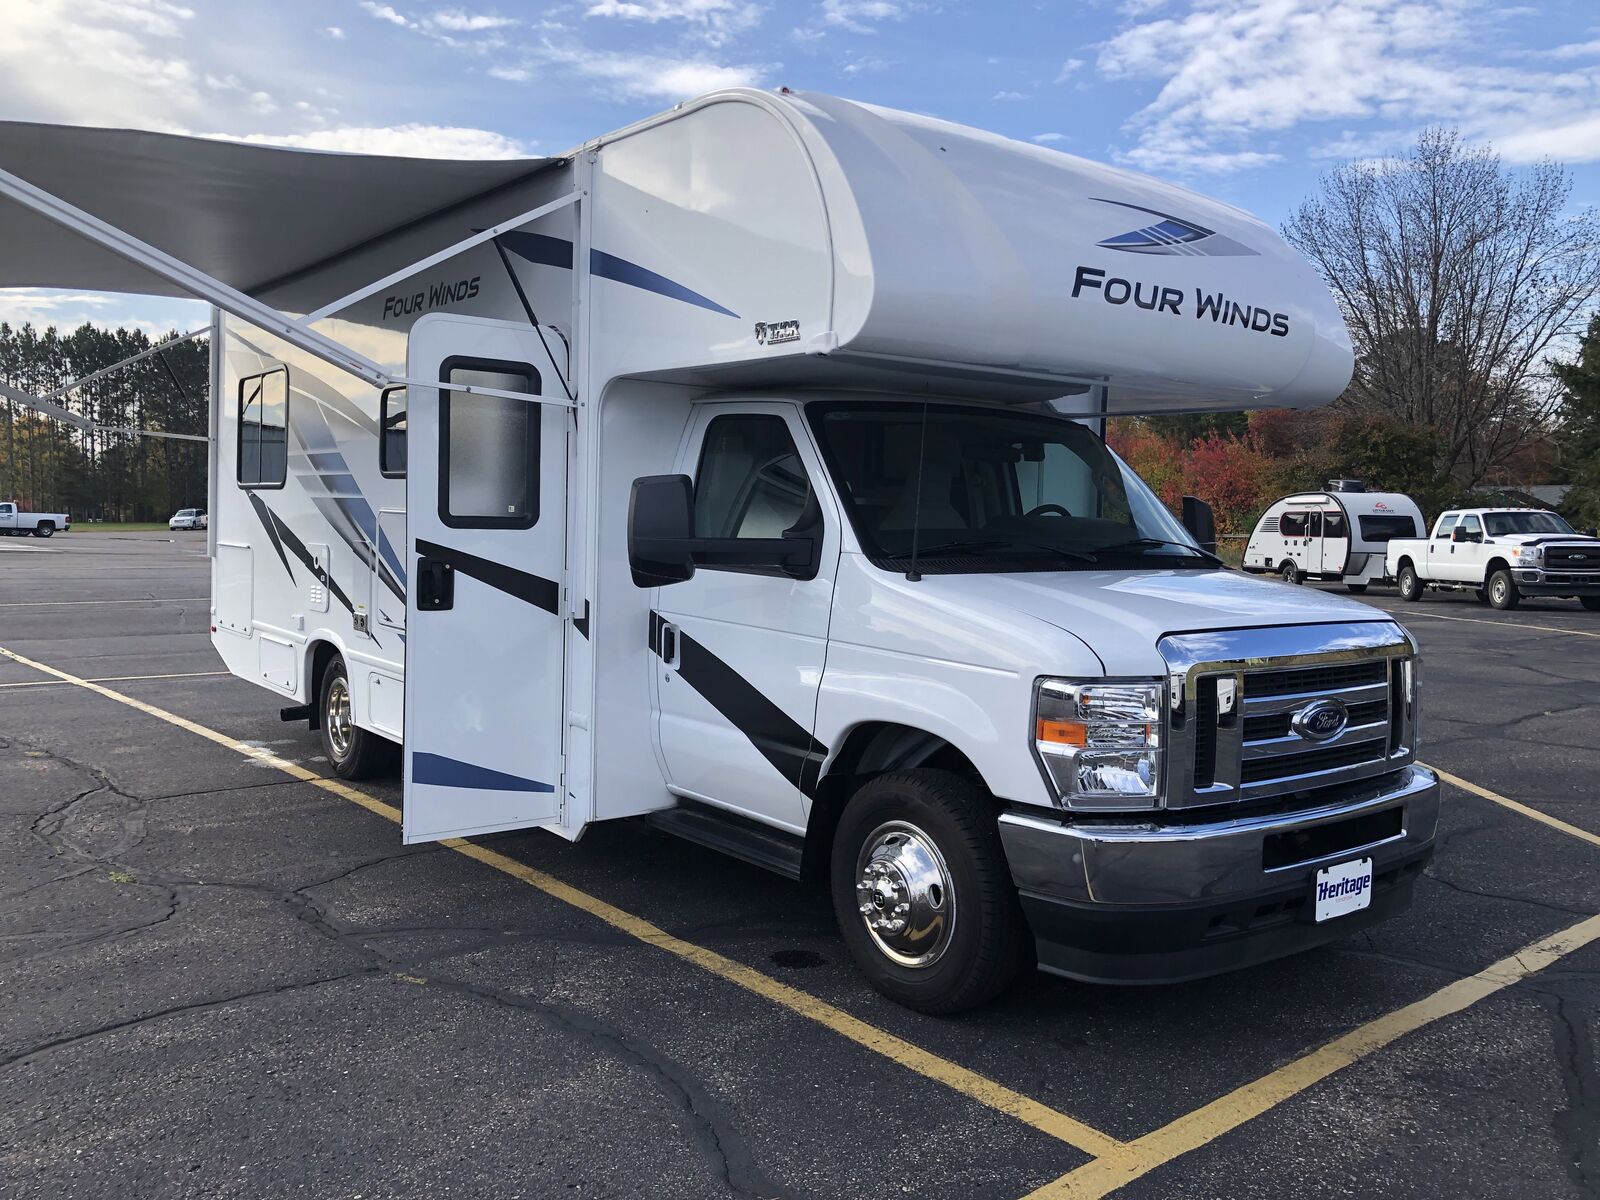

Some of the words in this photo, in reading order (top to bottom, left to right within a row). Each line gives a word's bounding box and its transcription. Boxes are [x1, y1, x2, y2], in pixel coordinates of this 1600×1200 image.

[383, 292, 425, 321] FOUR
[429, 276, 481, 308] WINDS
[1071, 265, 1184, 316] FOUR
[1195, 287, 1289, 337] WINDS
[1316, 711, 1340, 729] Ford
[1317, 874, 1371, 902] Heritage
